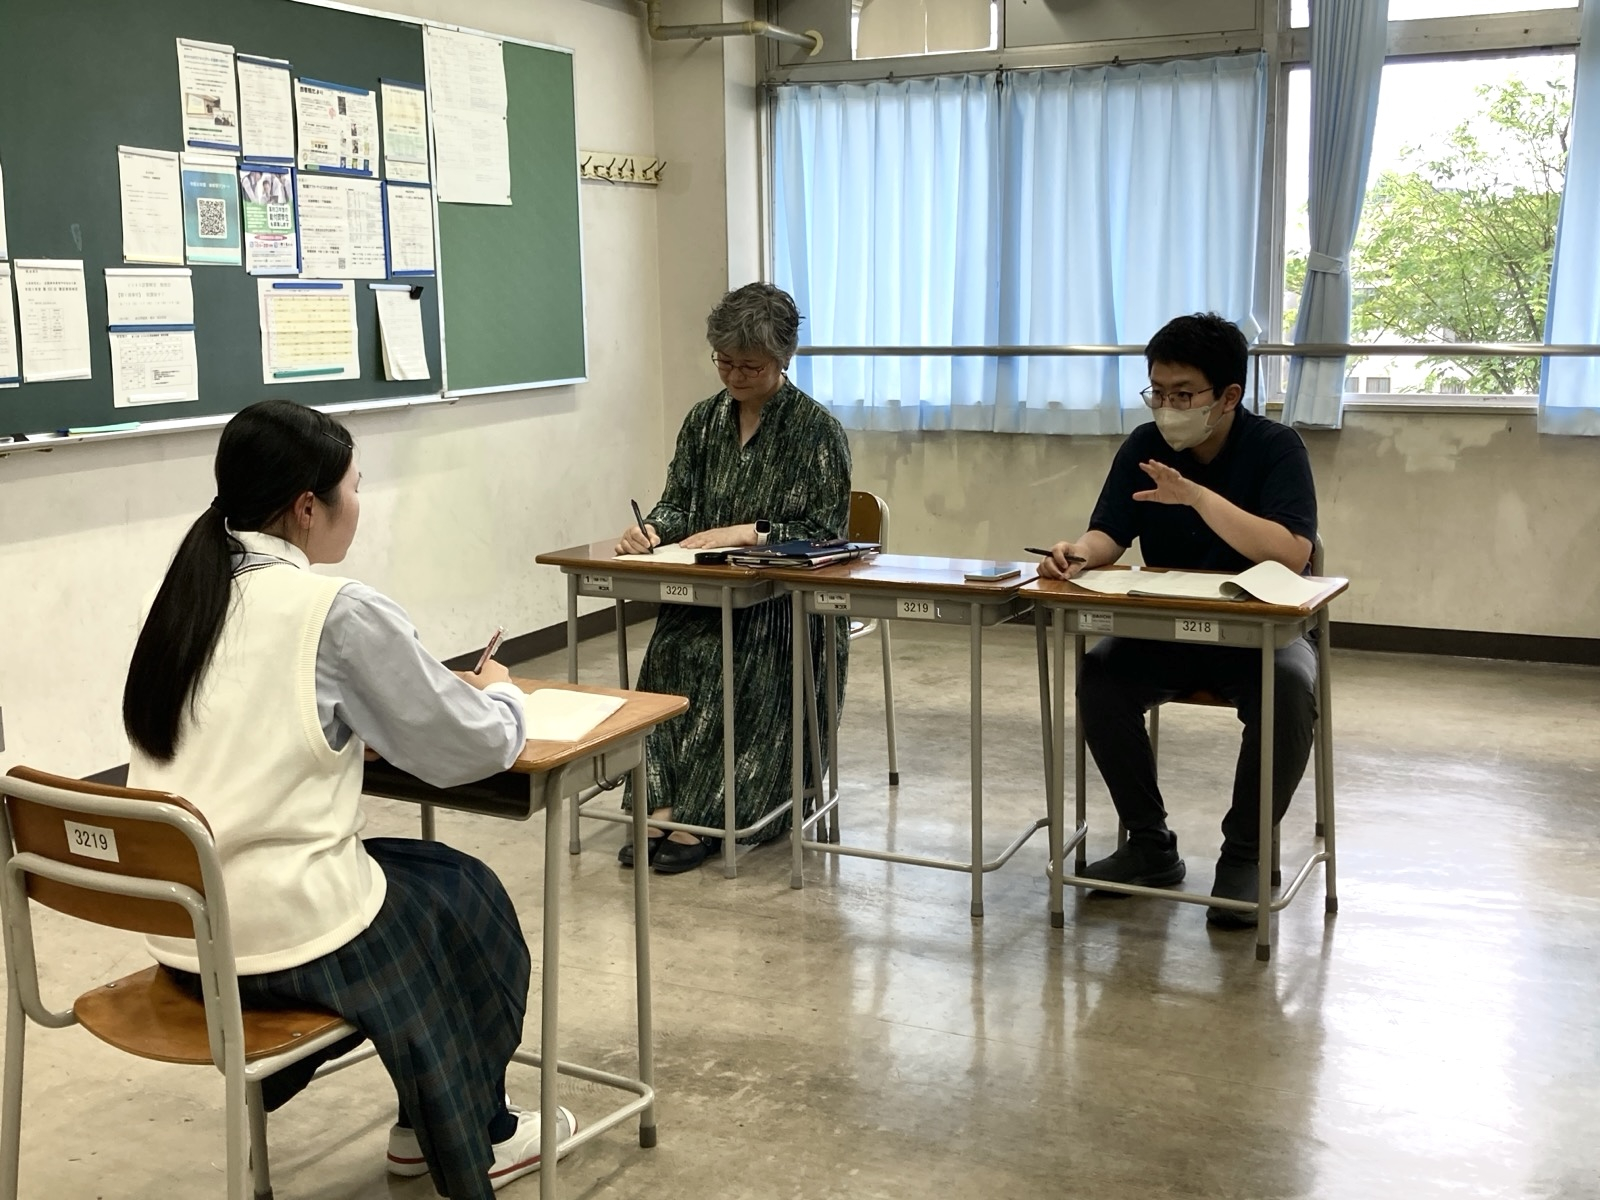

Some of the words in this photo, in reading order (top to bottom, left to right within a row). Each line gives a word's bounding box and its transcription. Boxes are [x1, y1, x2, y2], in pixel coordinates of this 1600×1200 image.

[666, 585, 688, 597] 3220
[820, 594, 825, 602] 1
[904, 602, 929, 613] 3219
[1083, 614, 1088, 623] 1
[1182, 621, 1211, 633] 3218
[74, 829, 108, 851] 3219
